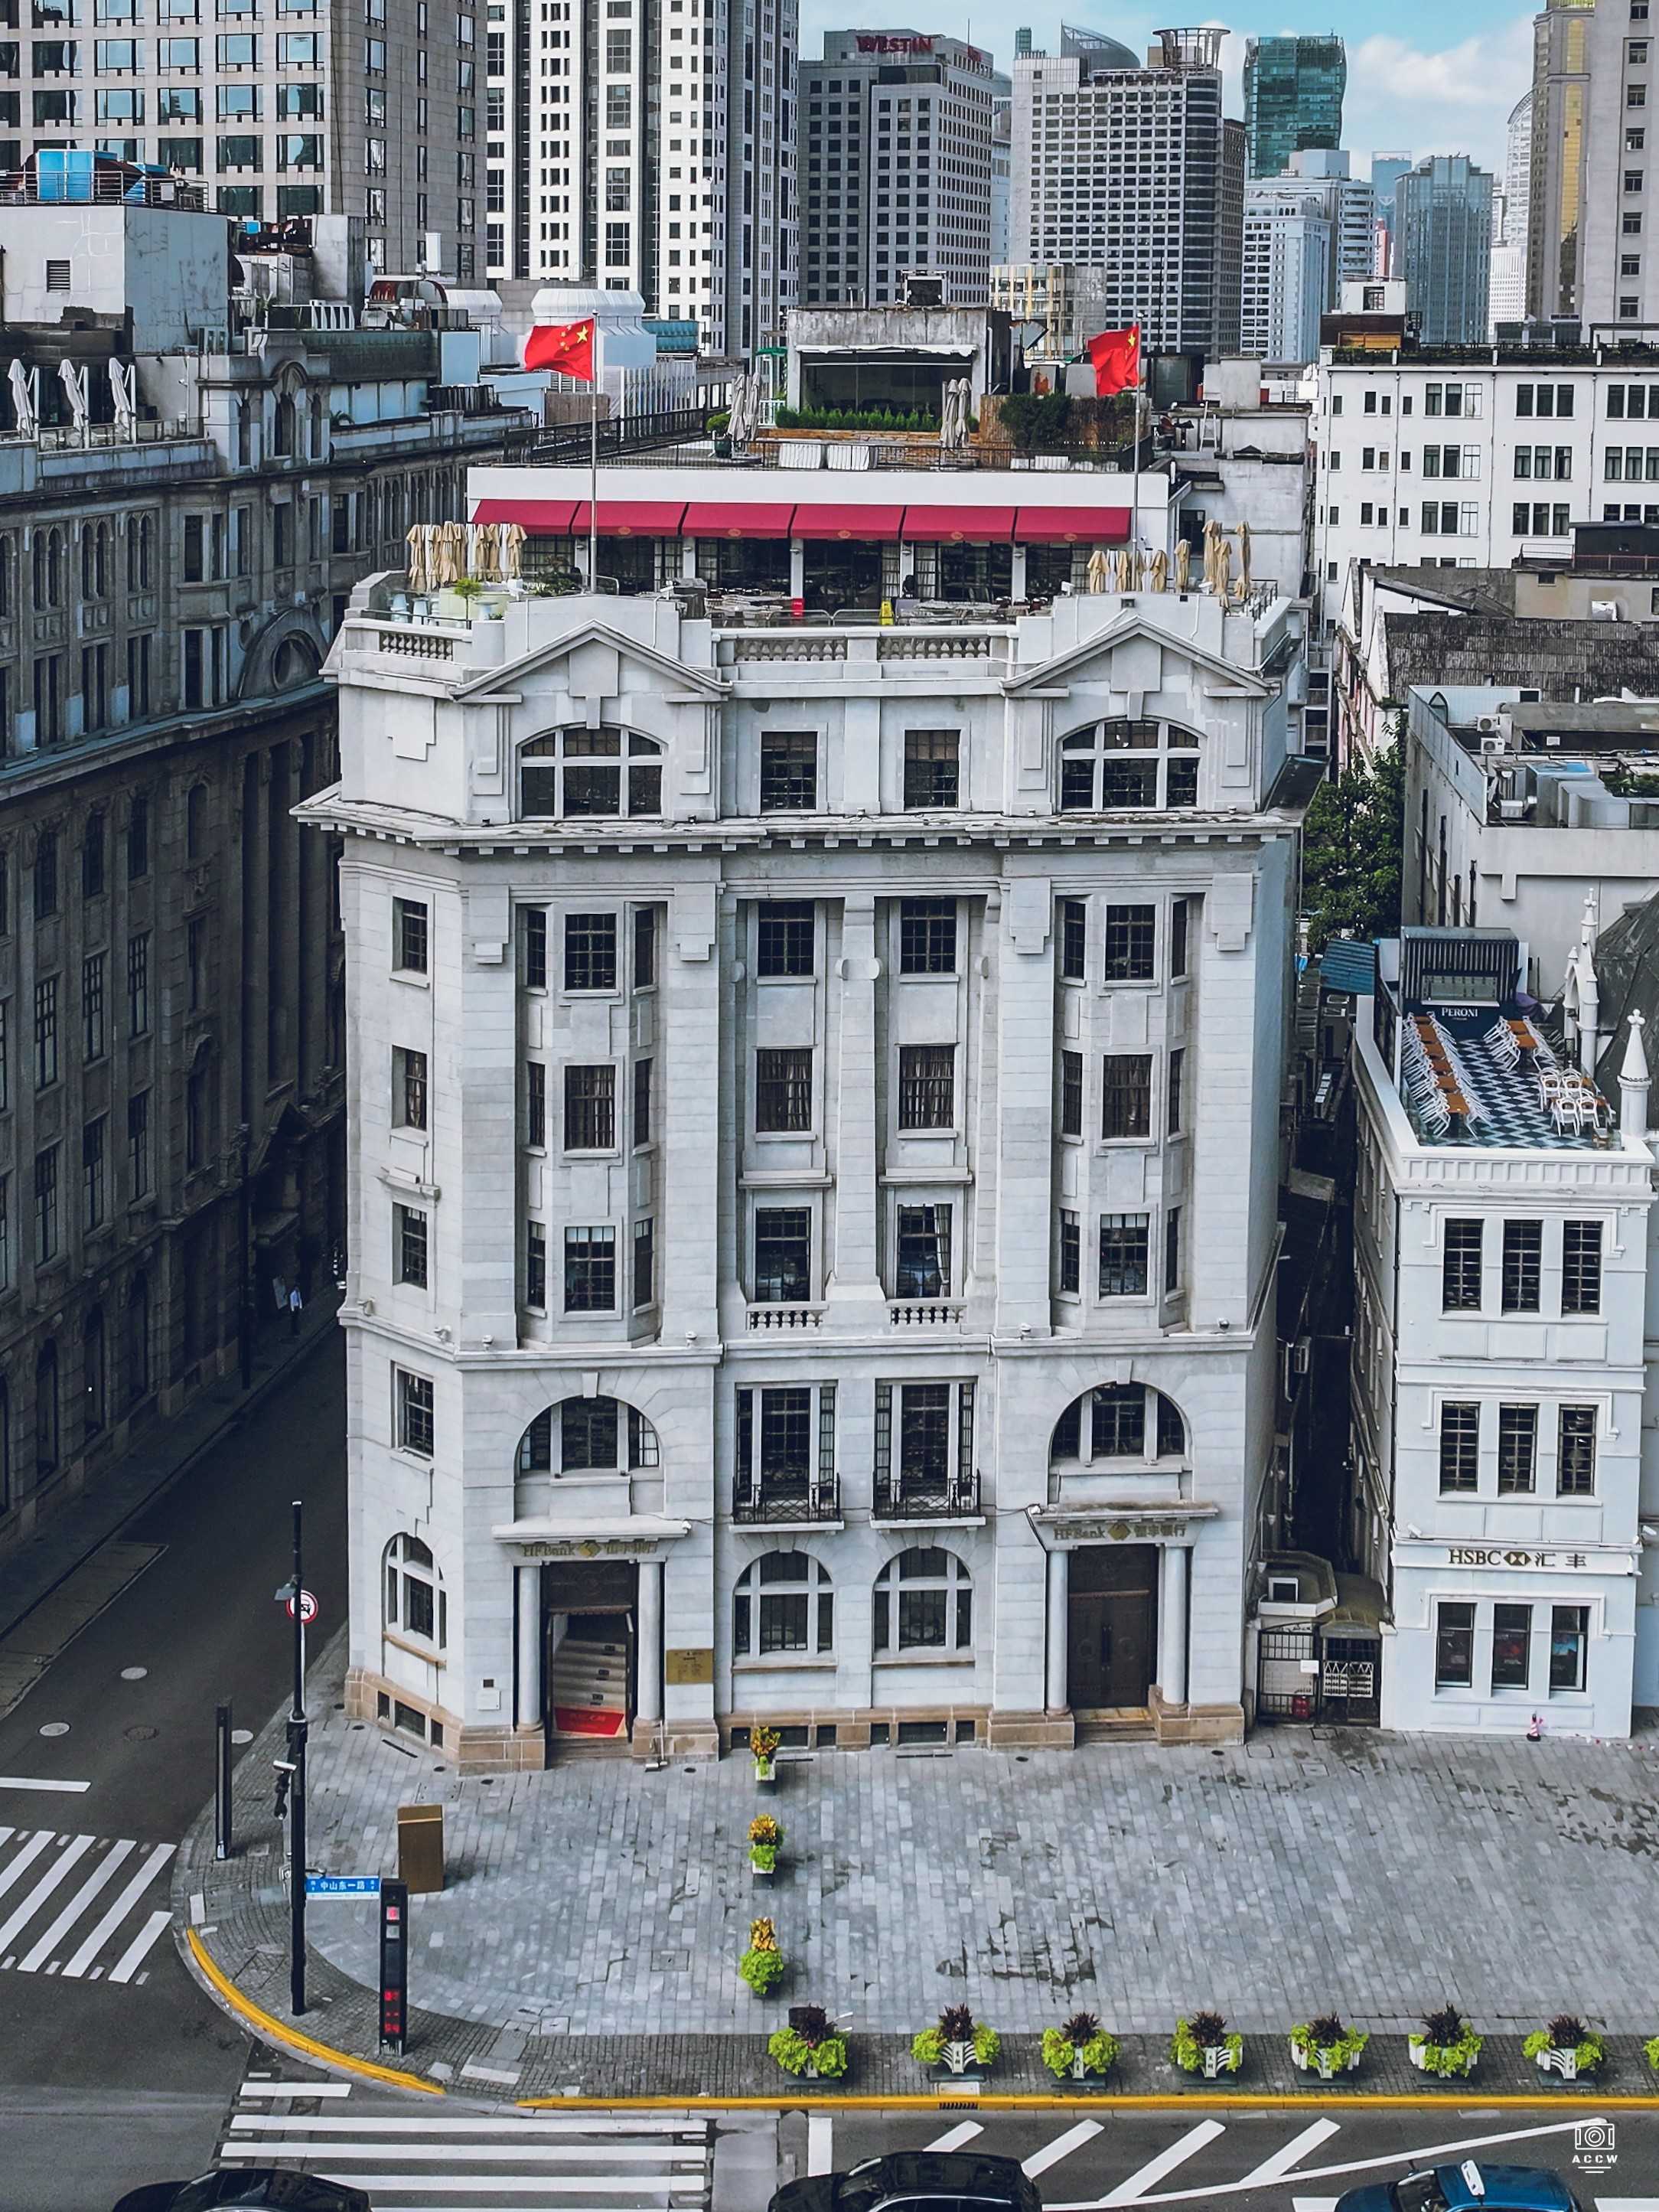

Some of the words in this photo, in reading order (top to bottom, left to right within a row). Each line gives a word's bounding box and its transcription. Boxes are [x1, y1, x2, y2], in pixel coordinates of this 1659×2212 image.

[856, 35, 932, 54] WESTIN
[1442, 1007, 1478, 1017] PERONI
[1448, 1548, 1501, 1565] HSBC
[320, 1880, 365, 1891] 中山东一路
